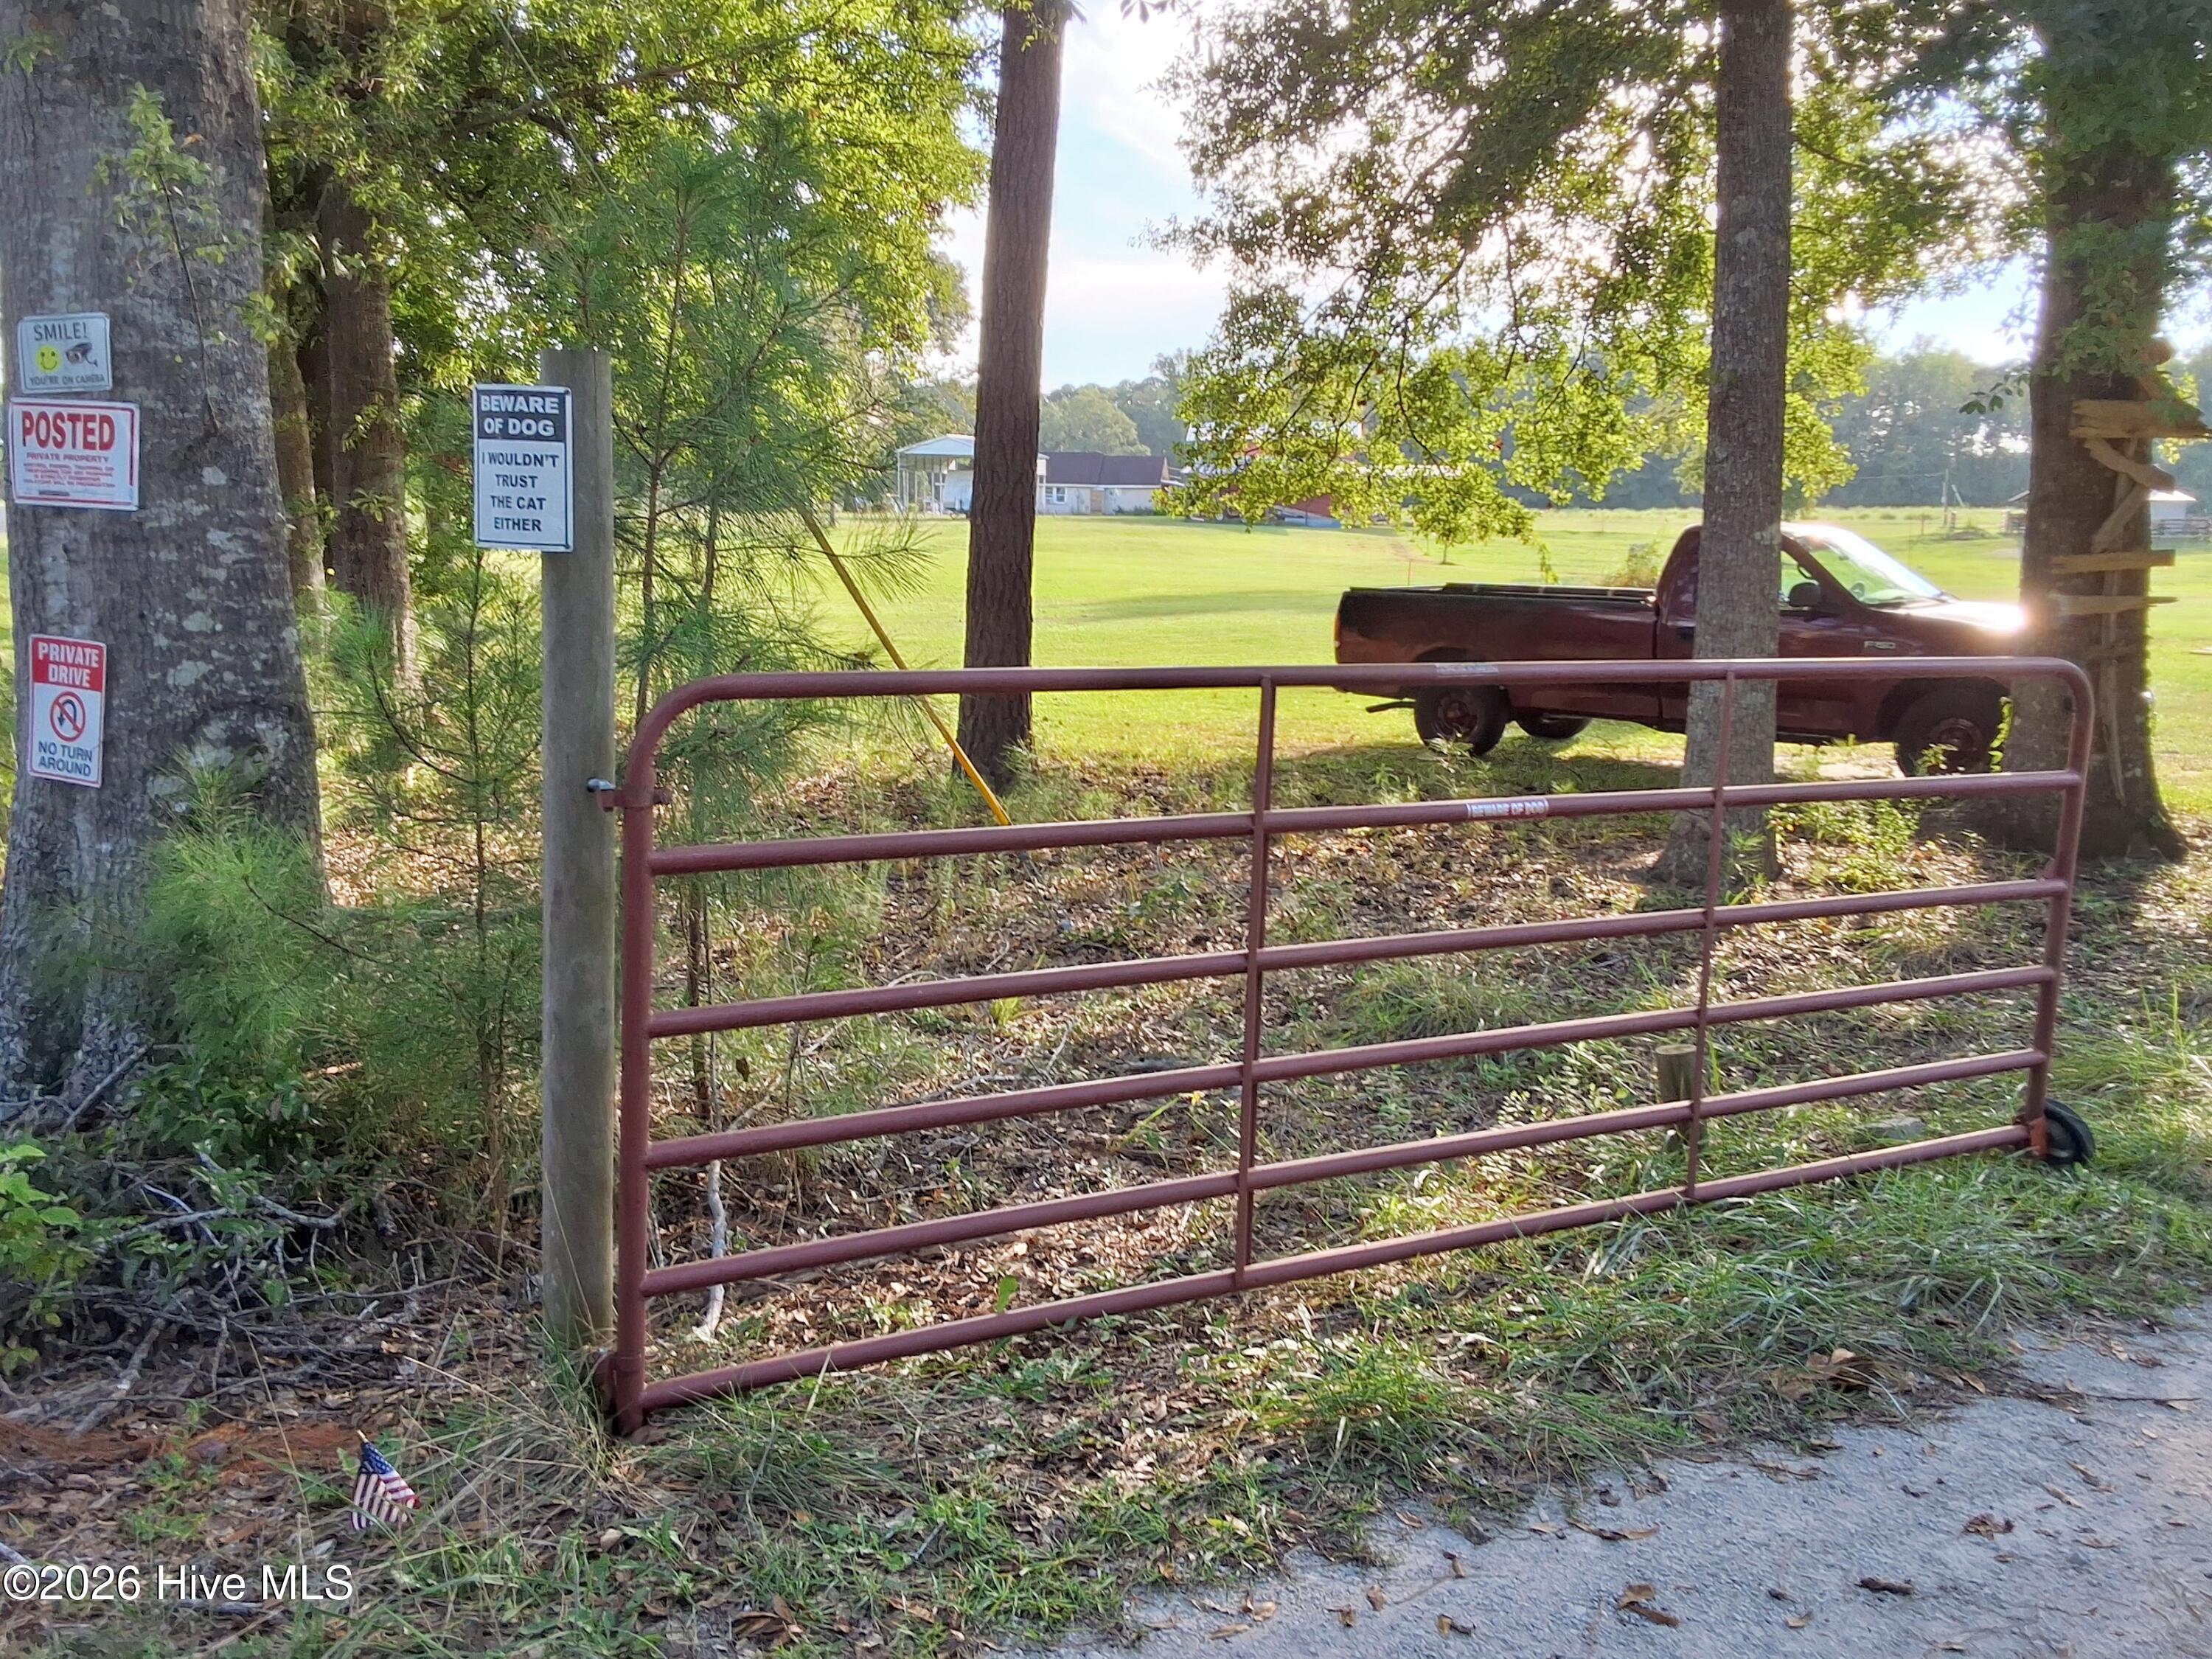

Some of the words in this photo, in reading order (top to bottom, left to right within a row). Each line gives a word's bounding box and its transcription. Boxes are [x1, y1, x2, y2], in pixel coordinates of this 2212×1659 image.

[34, 321, 88, 341] SMILE!
[61, 375, 73, 385] ON
[75, 374, 105, 384] CAMERA
[480, 394, 560, 414] BEWARE
[21, 411, 116, 451] POSTED
[484, 417, 504, 434] OF
[508, 418, 554, 437] DOG
[27, 452, 60, 461] PRIVATE
[63, 453, 109, 463] PROPERTY
[481, 452, 486, 465] I
[488, 452, 559, 468] WOULDN'T
[495, 473, 538, 488] TRUST
[490, 495, 512, 509] THE
[516, 496, 546, 510] CAT
[493, 517, 542, 532] EITHER
[38, 641, 100, 668] PRIVATE
[48, 664, 91, 687] DRIVE
[38, 740, 57, 756] NO
[60, 745, 93, 762] TURN
[38, 755, 91, 776] AROUND
